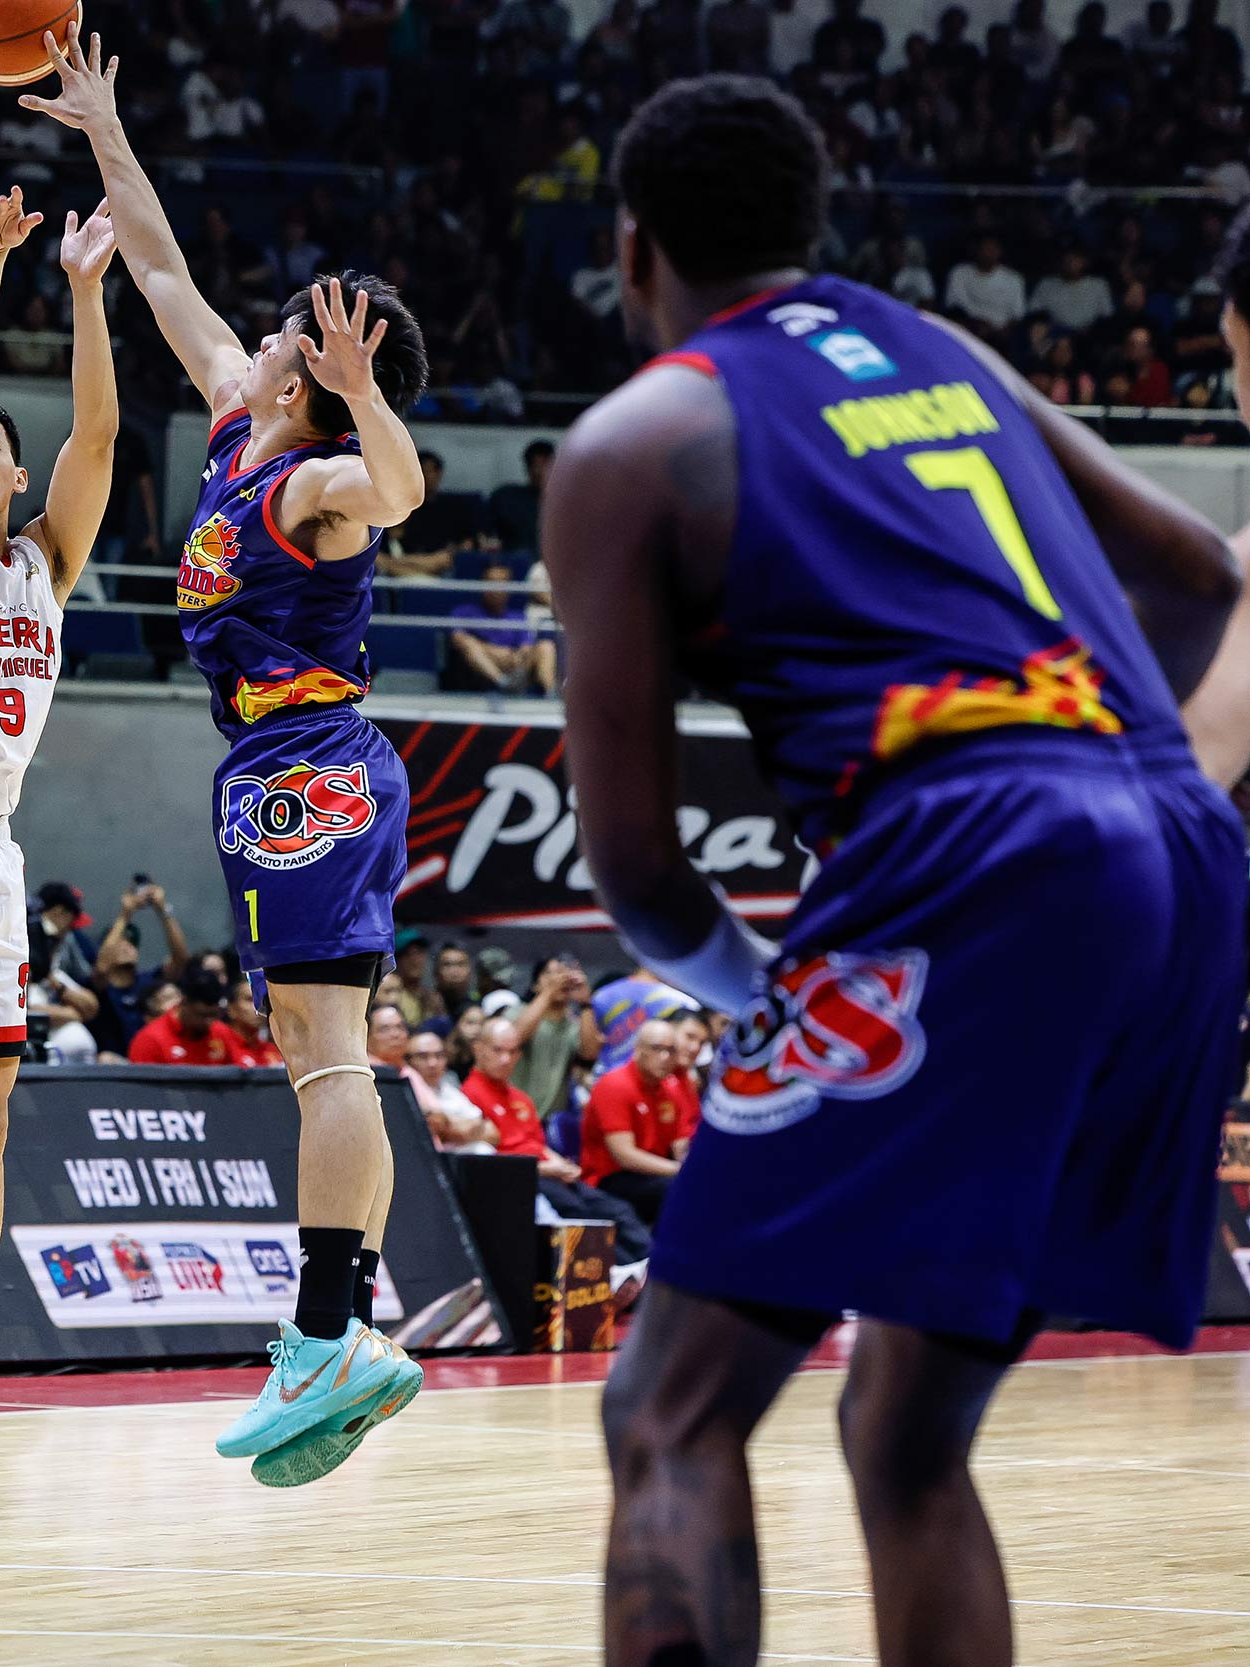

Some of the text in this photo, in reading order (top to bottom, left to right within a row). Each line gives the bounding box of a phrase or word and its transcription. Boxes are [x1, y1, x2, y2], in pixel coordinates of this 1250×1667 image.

[905, 446, 1063, 622] 7
[246, 839, 332, 867] ELASTO PAINTERS
[446, 763, 786, 893] Pia
[244, 889, 259, 942] 1
[88, 1108, 206, 1142] EVERY
[64, 1158, 278, 1208] WED FRI SUN
[75, 1259, 102, 1286] TV
